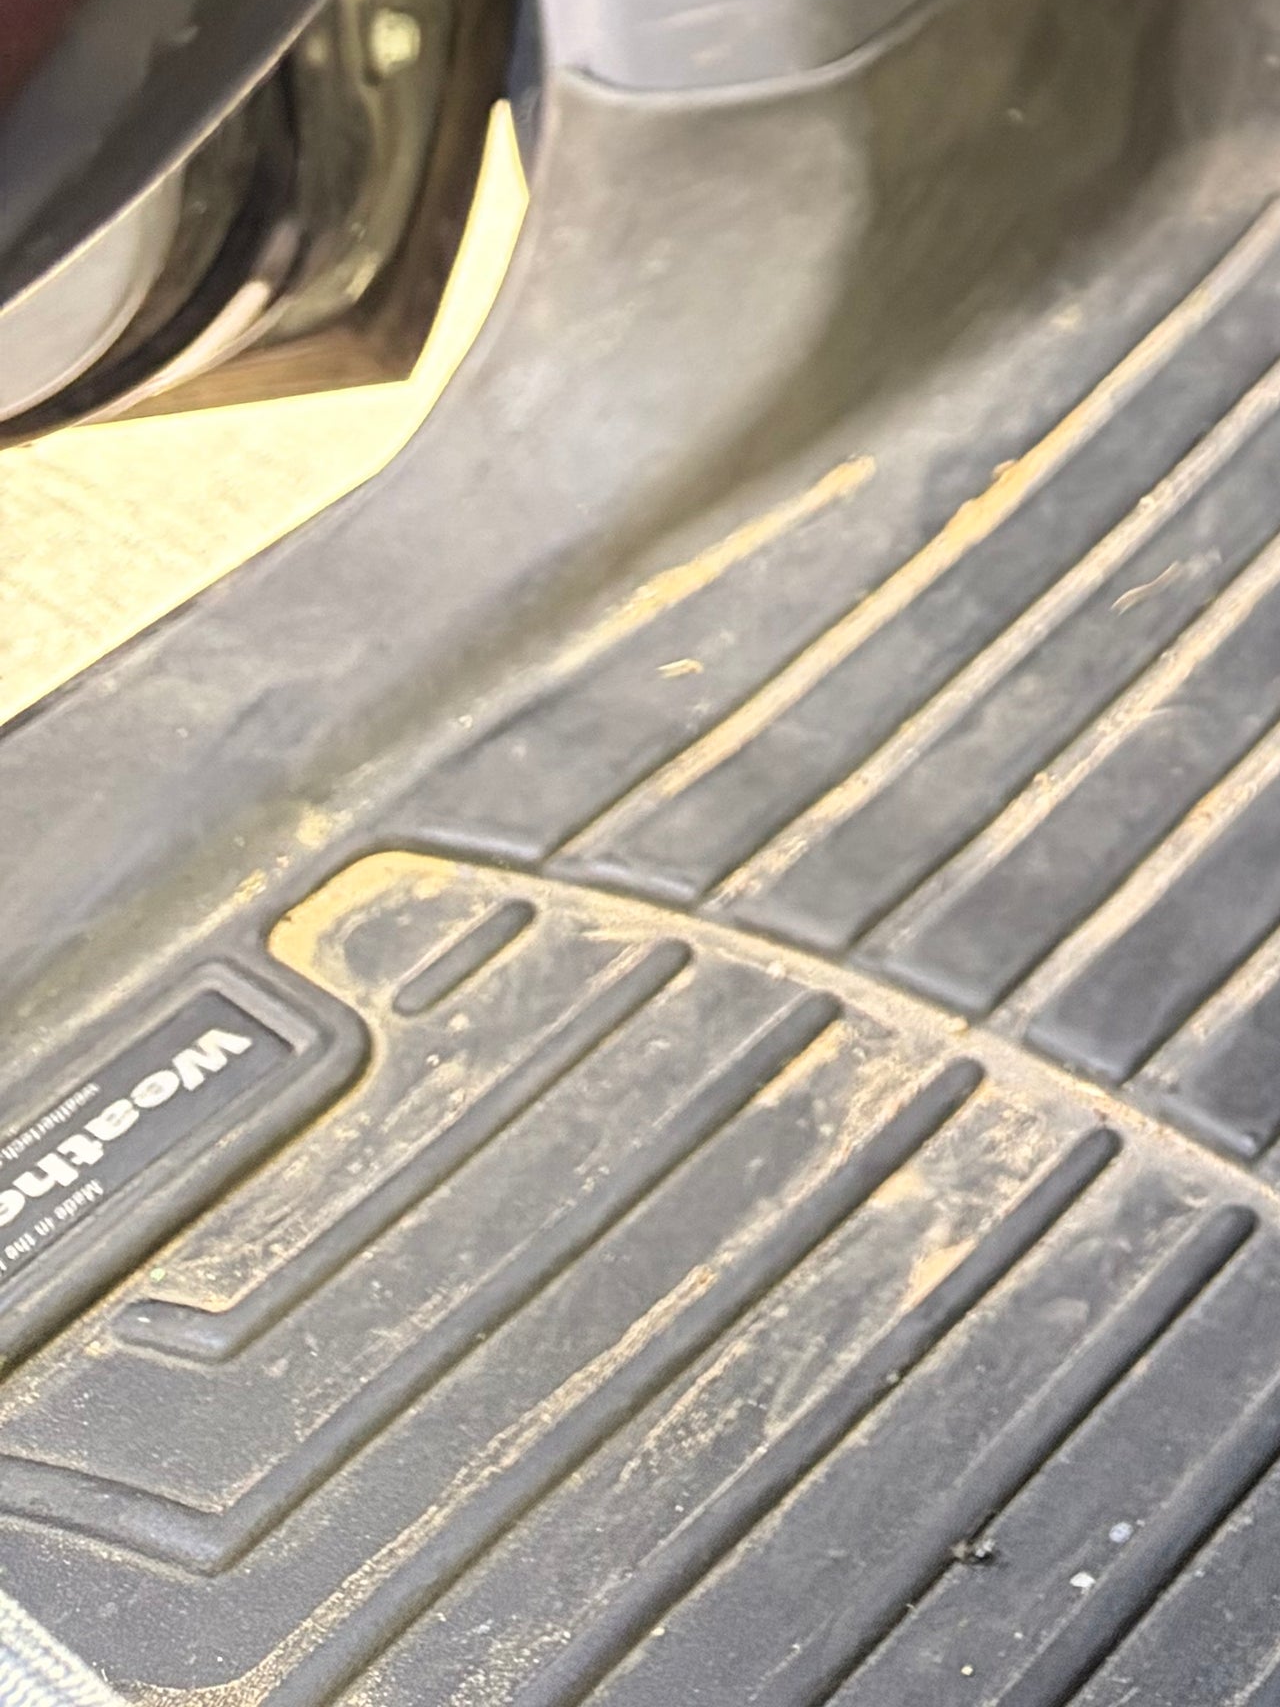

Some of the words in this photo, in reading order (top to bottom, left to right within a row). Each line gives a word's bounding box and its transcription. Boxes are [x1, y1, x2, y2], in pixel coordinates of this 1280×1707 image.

[54, 1179, 104, 1219] Made
[34, 1216, 55, 1236] in
[4, 1232, 37, 1260] the
